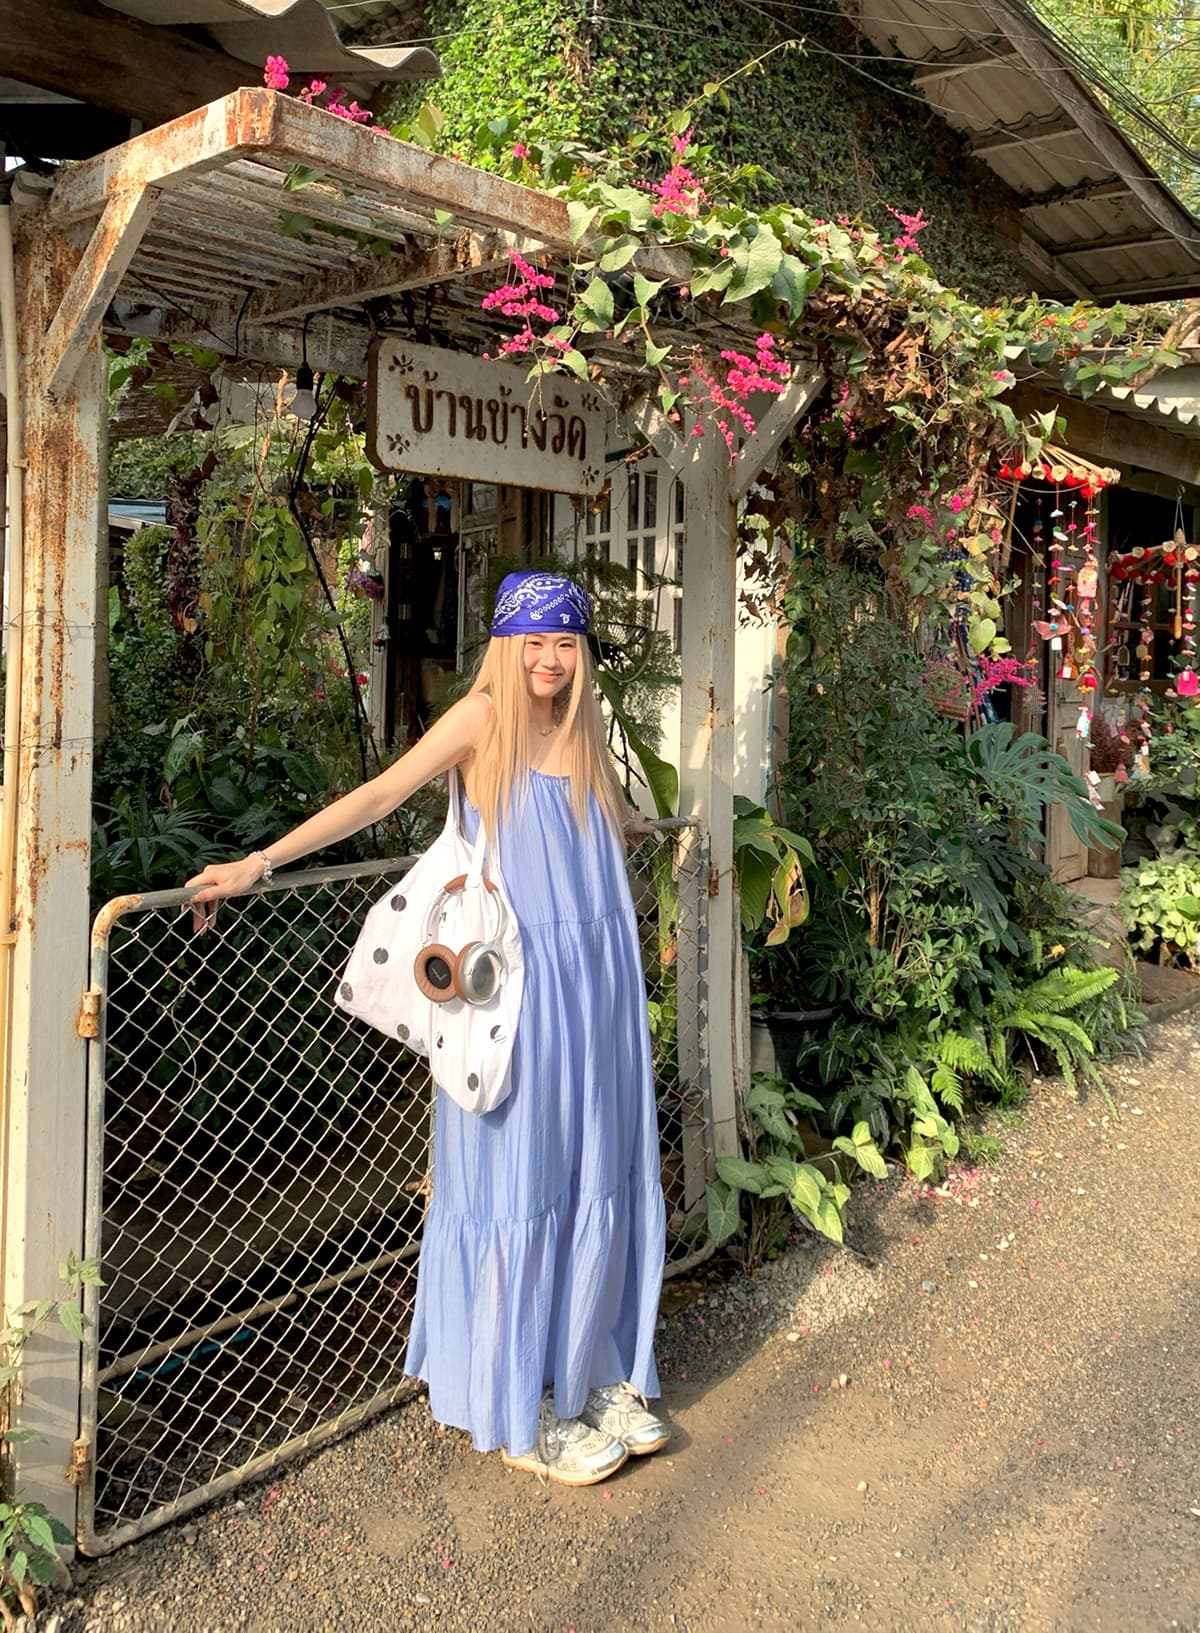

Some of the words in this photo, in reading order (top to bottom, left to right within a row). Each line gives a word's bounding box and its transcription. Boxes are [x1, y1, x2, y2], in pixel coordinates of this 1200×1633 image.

[405, 369, 586, 461] บ้านข้างวัด
[431, 967, 447, 981] L
